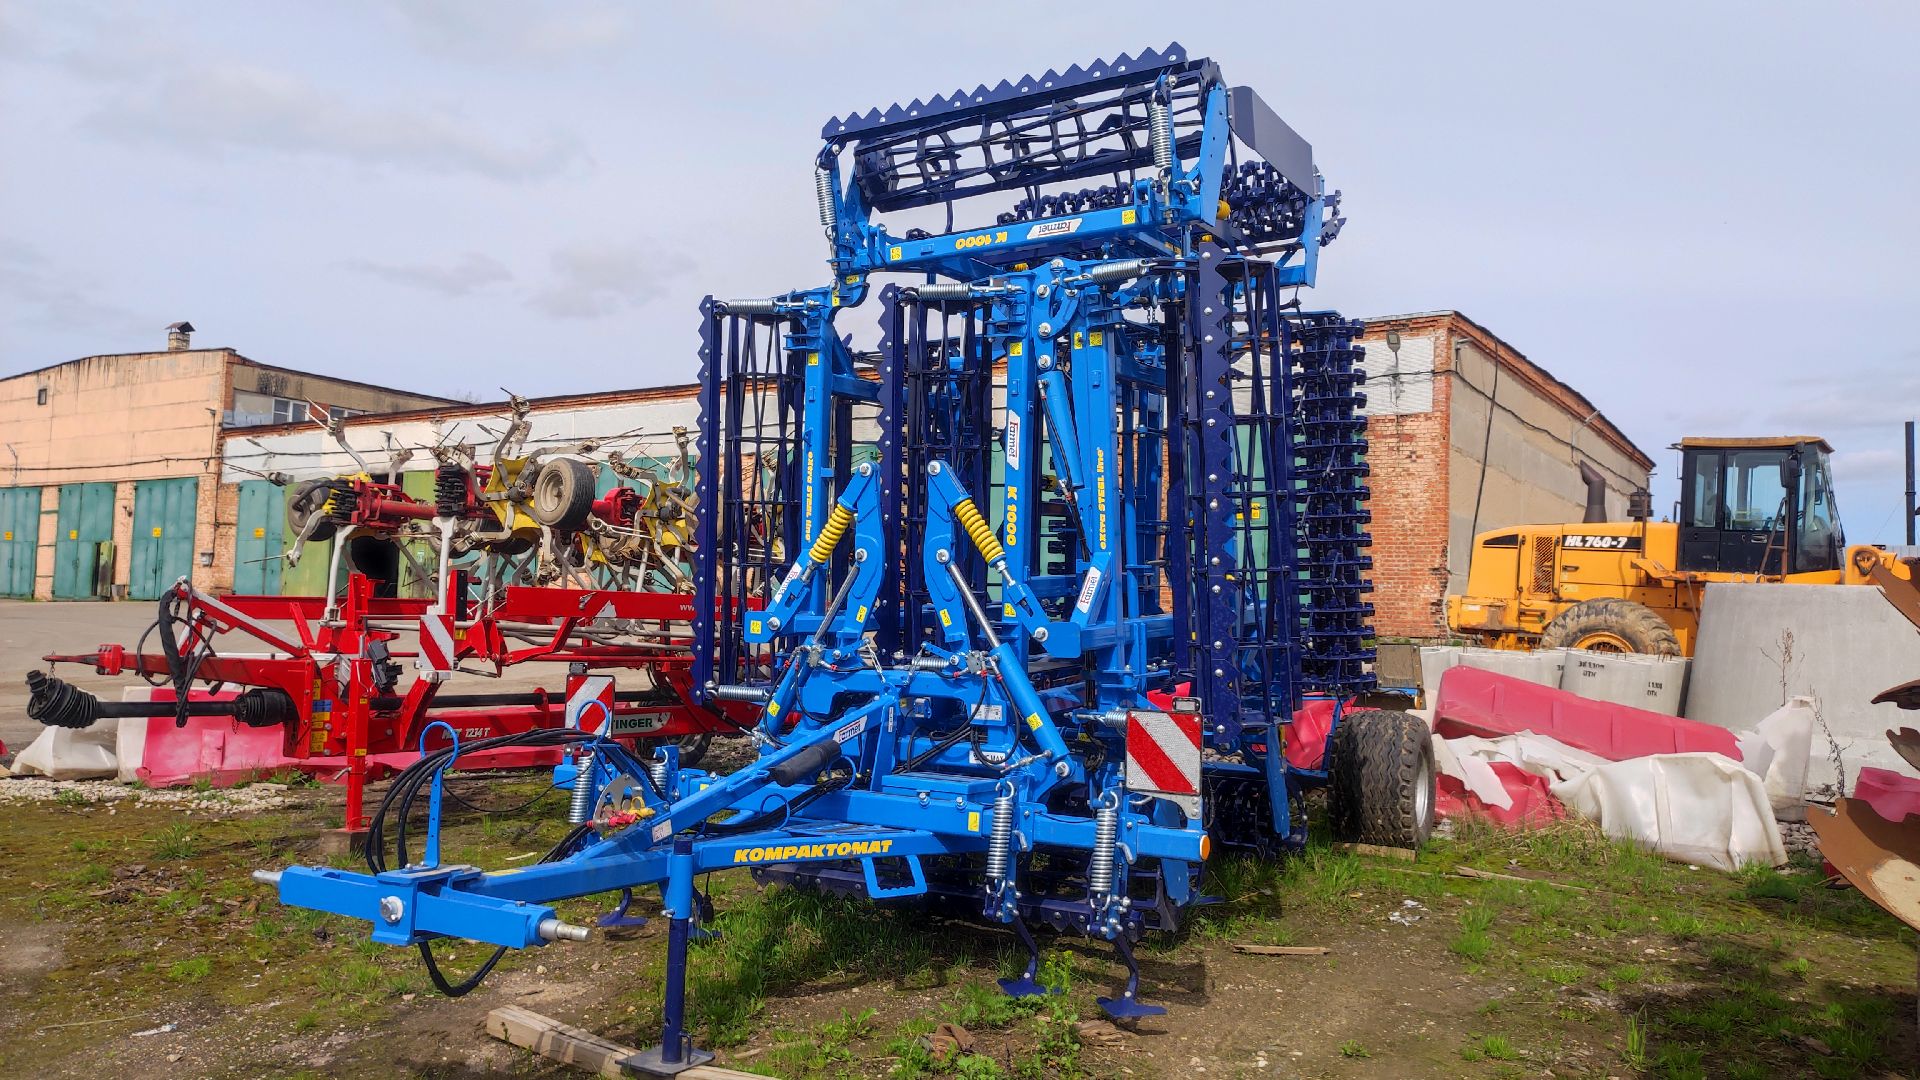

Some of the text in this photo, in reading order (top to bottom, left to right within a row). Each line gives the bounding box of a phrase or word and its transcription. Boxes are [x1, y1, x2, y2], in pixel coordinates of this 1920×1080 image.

[955, 231, 1008, 250] K 1000
[1008, 421, 1019, 458] Farmet
[1097, 475, 1106, 512] STEEL
[1006, 485, 1018, 546] K 1000
[1564, 535, 1628, 548] HL 760-7
[613, 717, 653, 730] INGER
[733, 839, 893, 863] KOMPAKTOMAT
